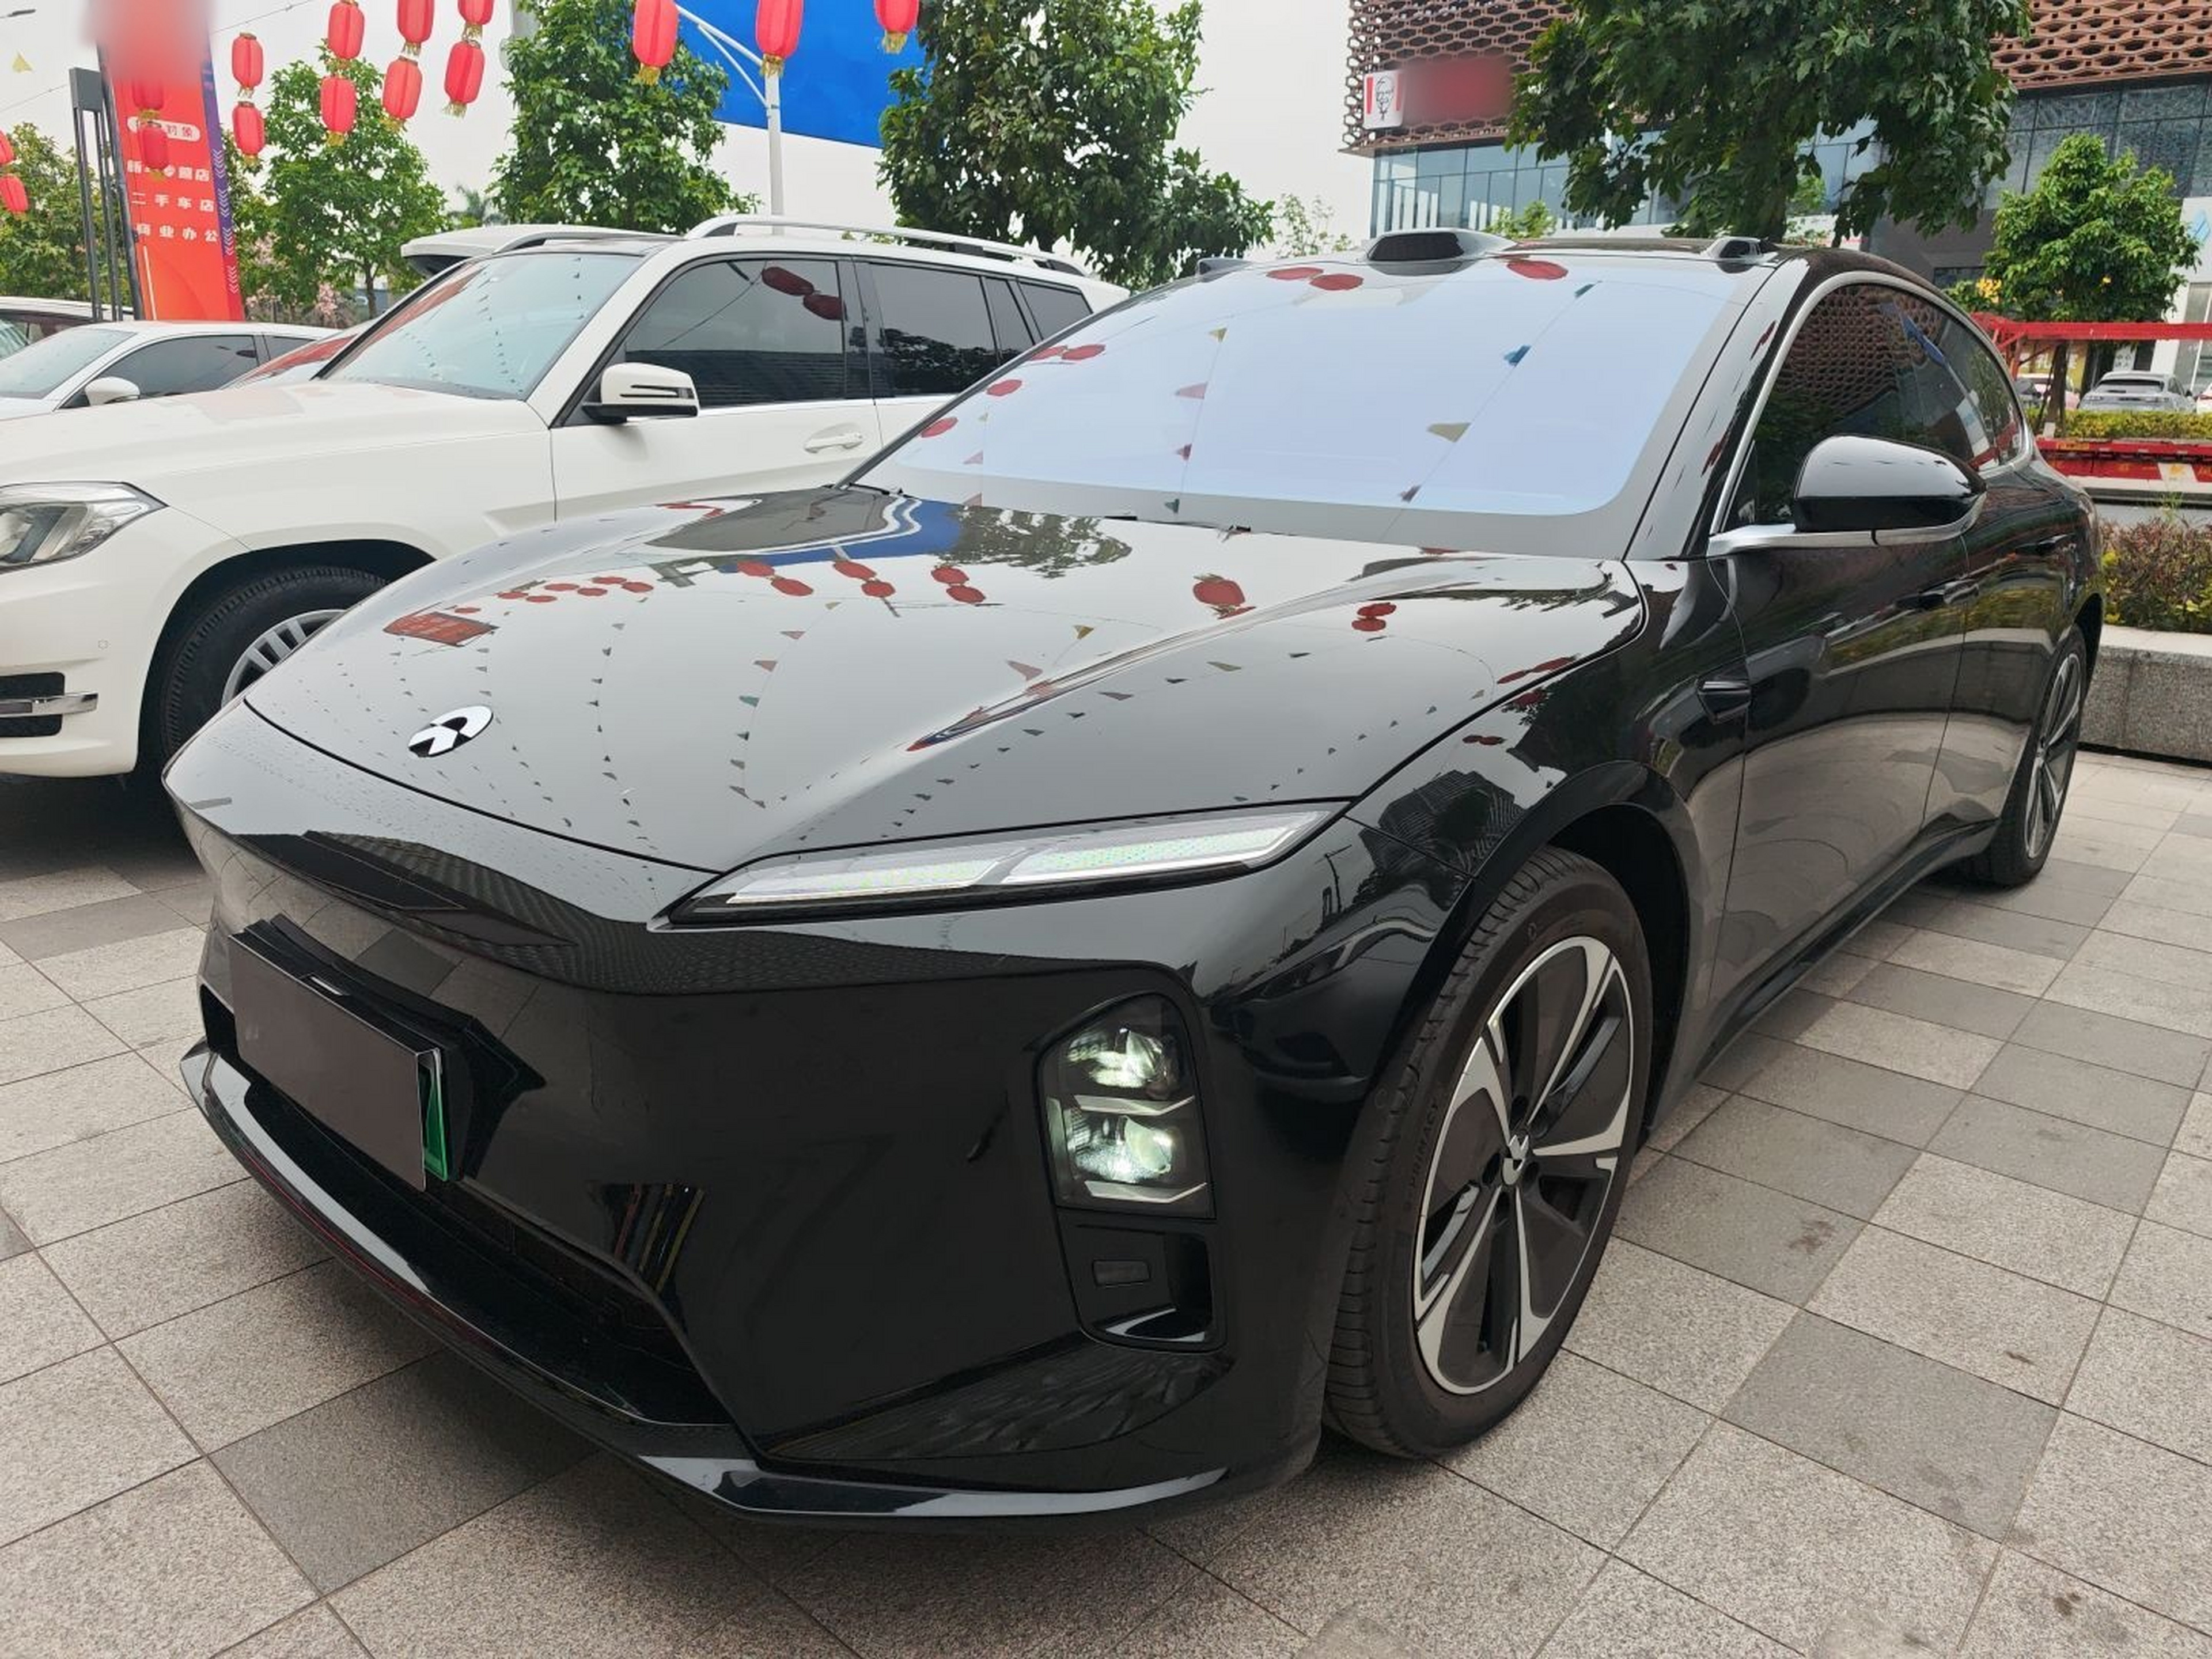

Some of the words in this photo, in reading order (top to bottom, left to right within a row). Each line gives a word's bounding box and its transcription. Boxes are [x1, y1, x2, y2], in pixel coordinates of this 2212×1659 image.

[131, 192, 214, 213] 二手车店
[136, 223, 219, 242] 商业办公
